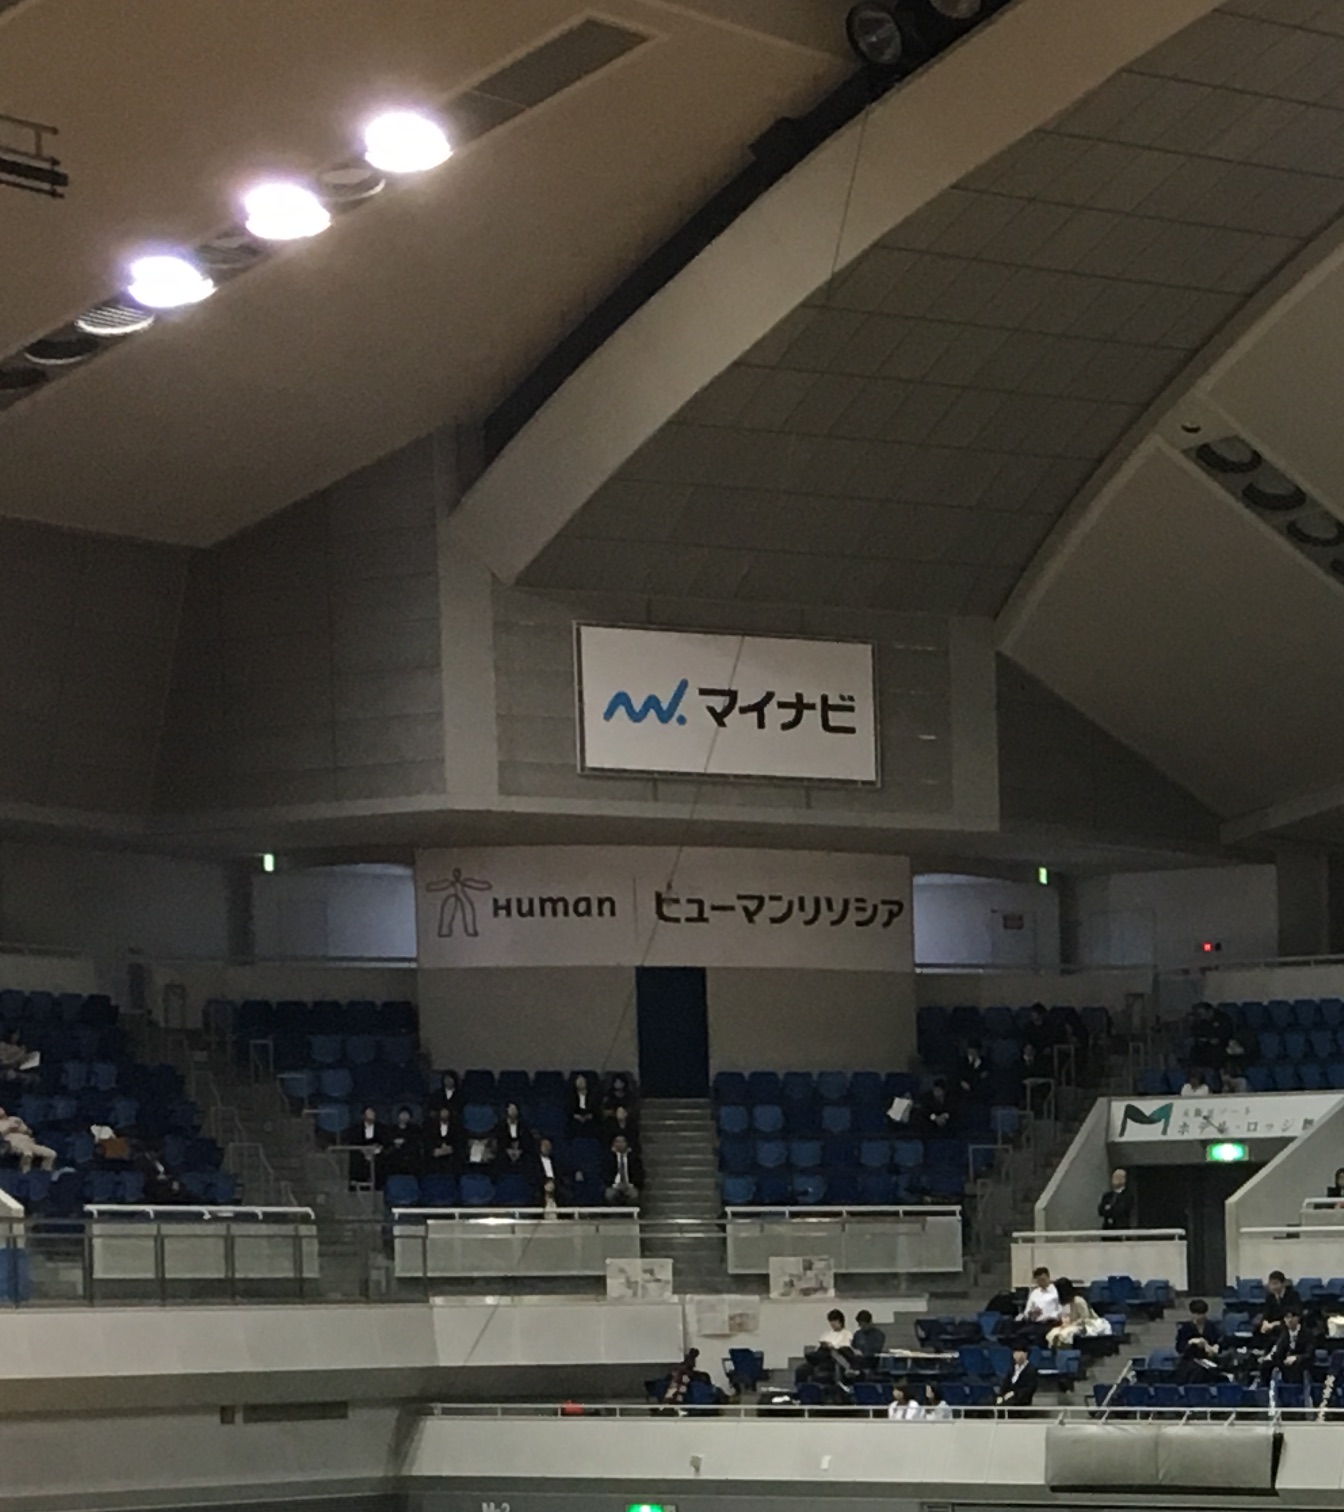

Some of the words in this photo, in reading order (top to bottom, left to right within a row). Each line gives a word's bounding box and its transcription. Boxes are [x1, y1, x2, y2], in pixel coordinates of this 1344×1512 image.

[698, 687, 857, 735] マイナビ
[492, 894, 617, 918] Human
[654, 889, 905, 928] ヒューマンリソシア
